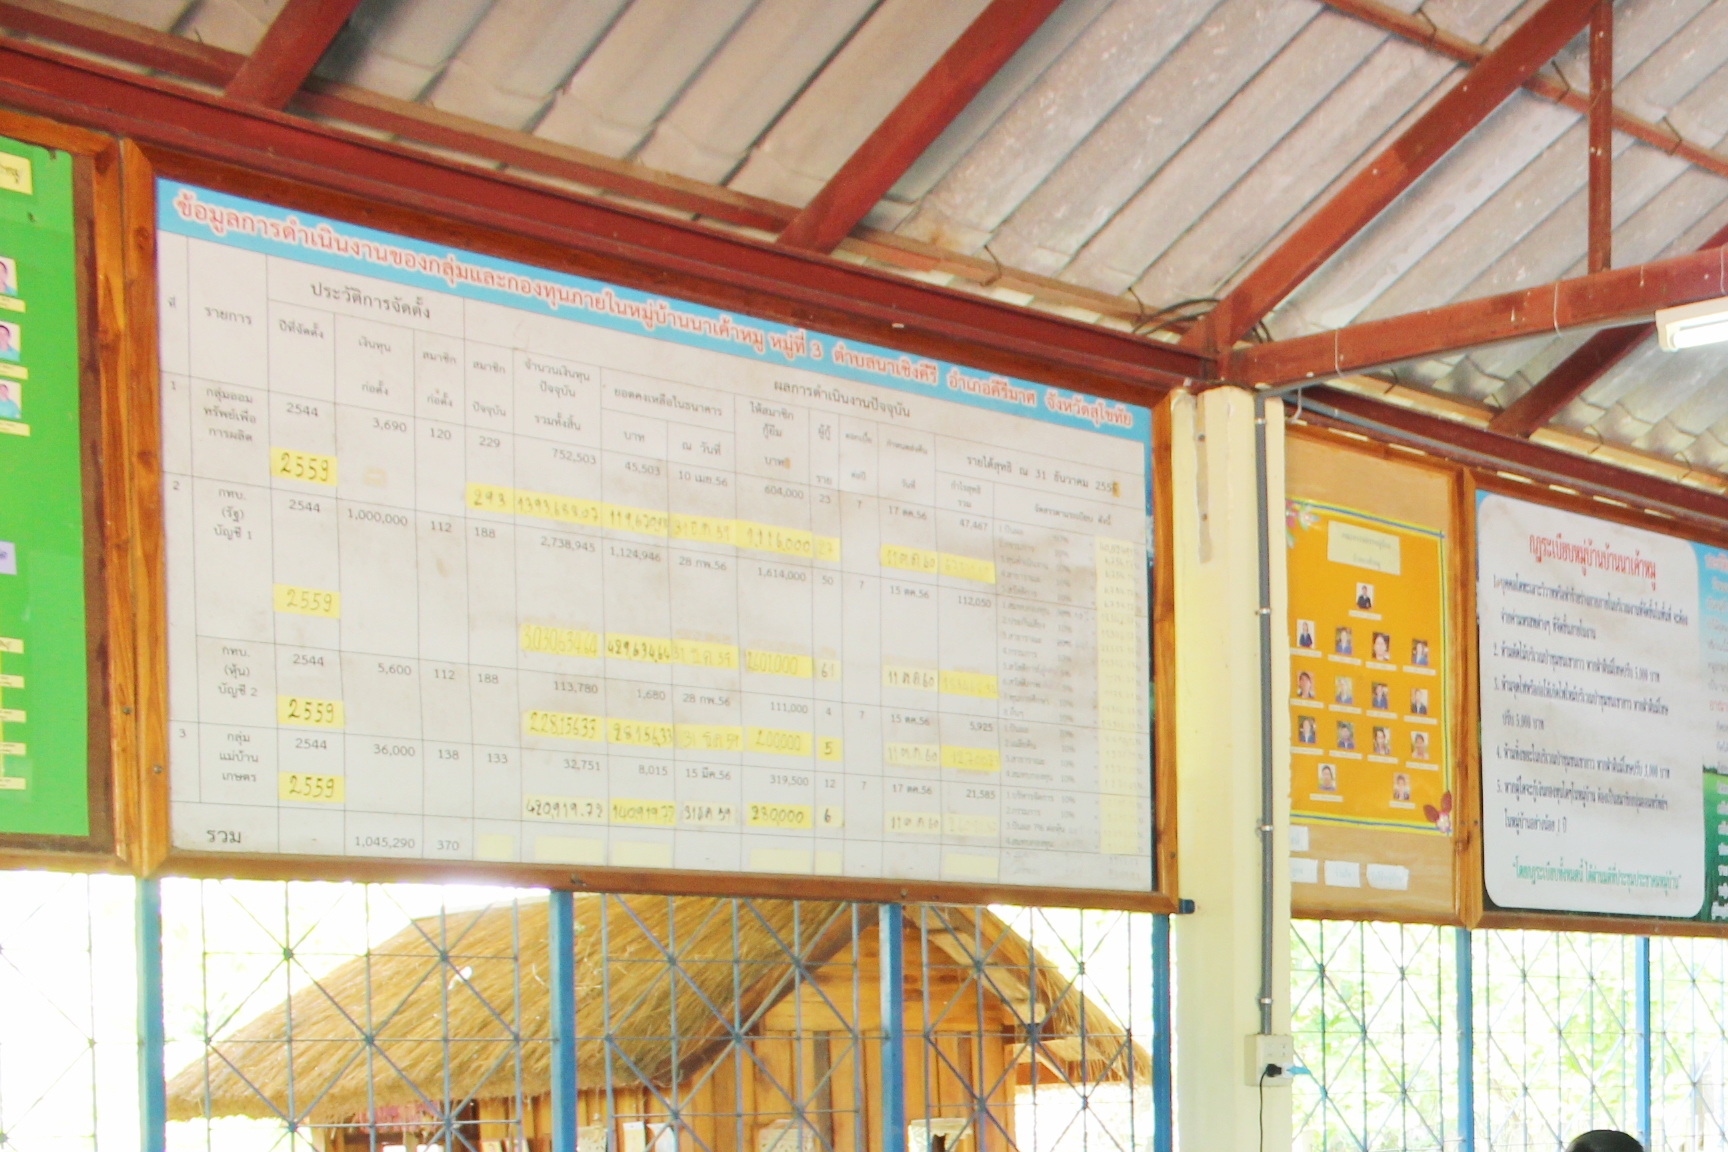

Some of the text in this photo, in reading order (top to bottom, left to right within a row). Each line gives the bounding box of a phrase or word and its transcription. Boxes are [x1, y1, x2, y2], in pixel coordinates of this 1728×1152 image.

[204, 305, 252, 326] รายการ
[311, 282, 912, 419] ประวัติการจัดตั้ง ผลการดำเนินงานปัจจุบัน
[770, 328, 808, 360] หมู่ที่
[811, 340, 823, 359] 3
[1045, 392, 1134, 430] จังหวัดสุโขทัย
[614, 387, 723, 417] ยอดคงเหลือในธนาคาร
[286, 402, 319, 418] 2544
[372, 417, 408, 435] 3,690
[429, 427, 452, 441] 120
[479, 435, 501, 449] 229
[552, 448, 597, 465] 752,503
[624, 461, 661, 477] 45,503
[678, 470, 691, 481] 10
[623, 429, 645, 443] บาท
[280, 452, 330, 483] 2559
[289, 499, 321, 514] 2544
[347, 508, 408, 527] 1,000,000
[430, 521, 452, 534] 112
[474, 526, 496, 540] 188
[540, 536, 596, 554] 2,738,945
[610, 546, 661, 563] 1,124,946
[678, 555, 692, 568] 28
[286, 587, 333, 613] 2559
[292, 653, 325, 668] 2544
[377, 661, 412, 678] 5,600
[433, 668, 456, 681] 112
[476, 672, 499, 685] 188
[553, 681, 599, 695] 113,780
[636, 688, 666, 701] 1,680
[682, 693, 696, 703] 28
[287, 698, 335, 724] 2559
[178, 728, 187, 739] 3
[295, 737, 328, 751] 2544
[373, 743, 416, 758] 36,000
[437, 748, 460, 761] 138
[486, 752, 509, 765] 133
[562, 758, 600, 773] 32,751
[638, 764, 669, 778] 8,015
[685, 767, 699, 779] 15
[824, 778, 836, 789] 12
[288, 774, 335, 798] 2559
[206, 829, 460, 852] รวม 1,045,290 370
